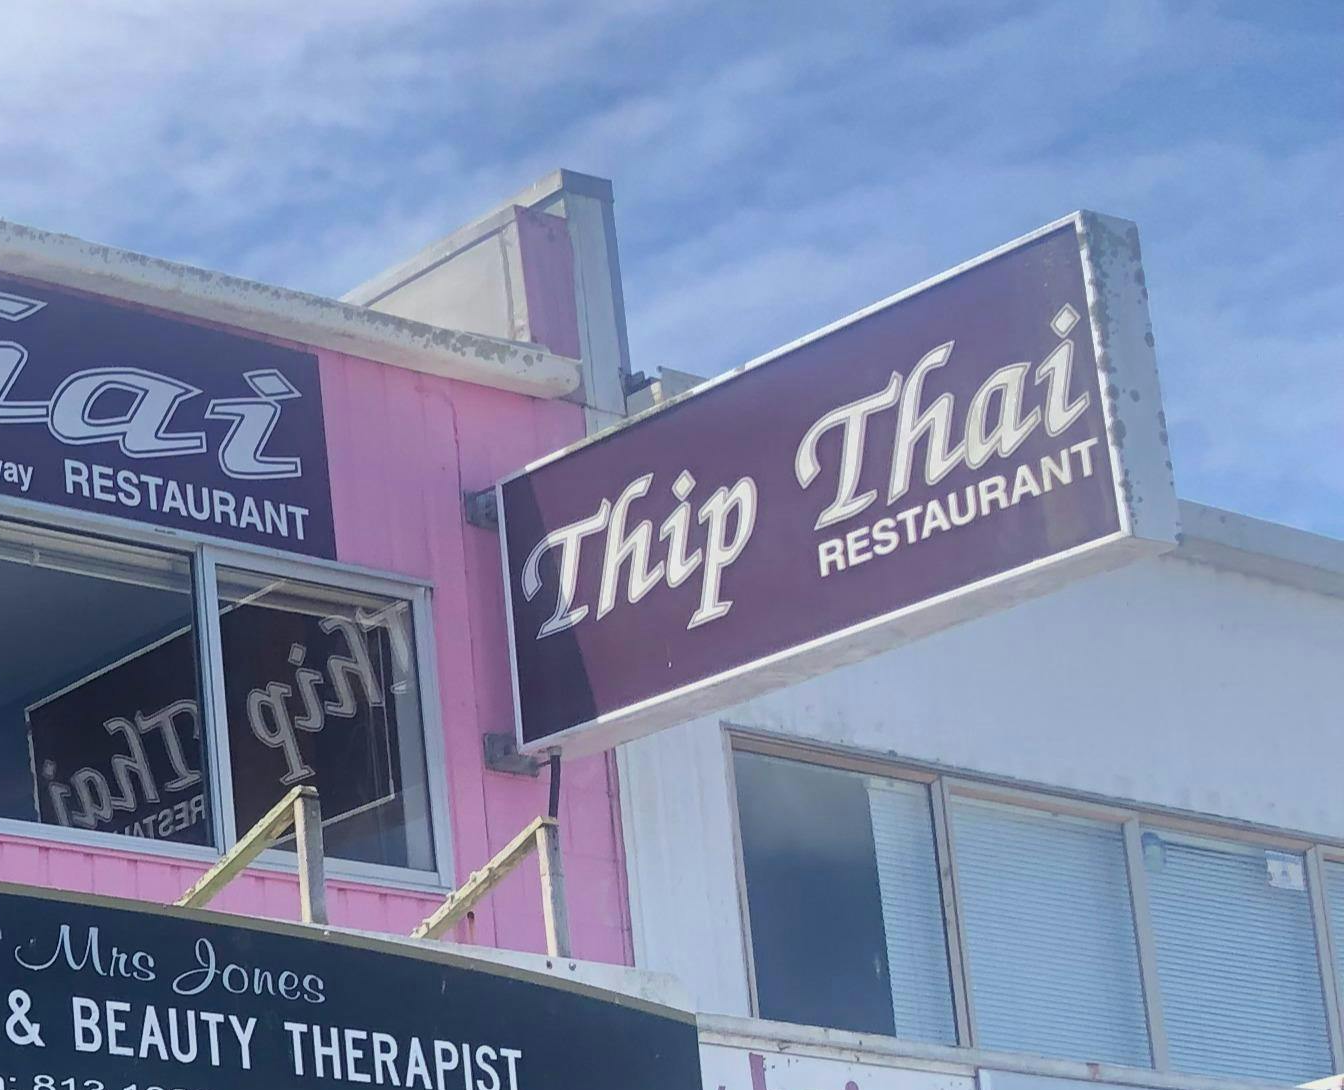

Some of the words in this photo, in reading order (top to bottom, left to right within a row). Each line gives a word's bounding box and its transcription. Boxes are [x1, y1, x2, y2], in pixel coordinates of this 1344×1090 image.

[64, 459, 310, 542] RESTAURANT
[522, 470, 757, 639] Thip
[794, 302, 1090, 530] Thai
[817, 437, 1097, 578] RESTAURANT
[15, 925, 155, 980] Mrs
[173, 938, 325, 1002] Jones
[6, 990, 45, 1046] &
[73, 997, 257, 1069] BEAUTY
